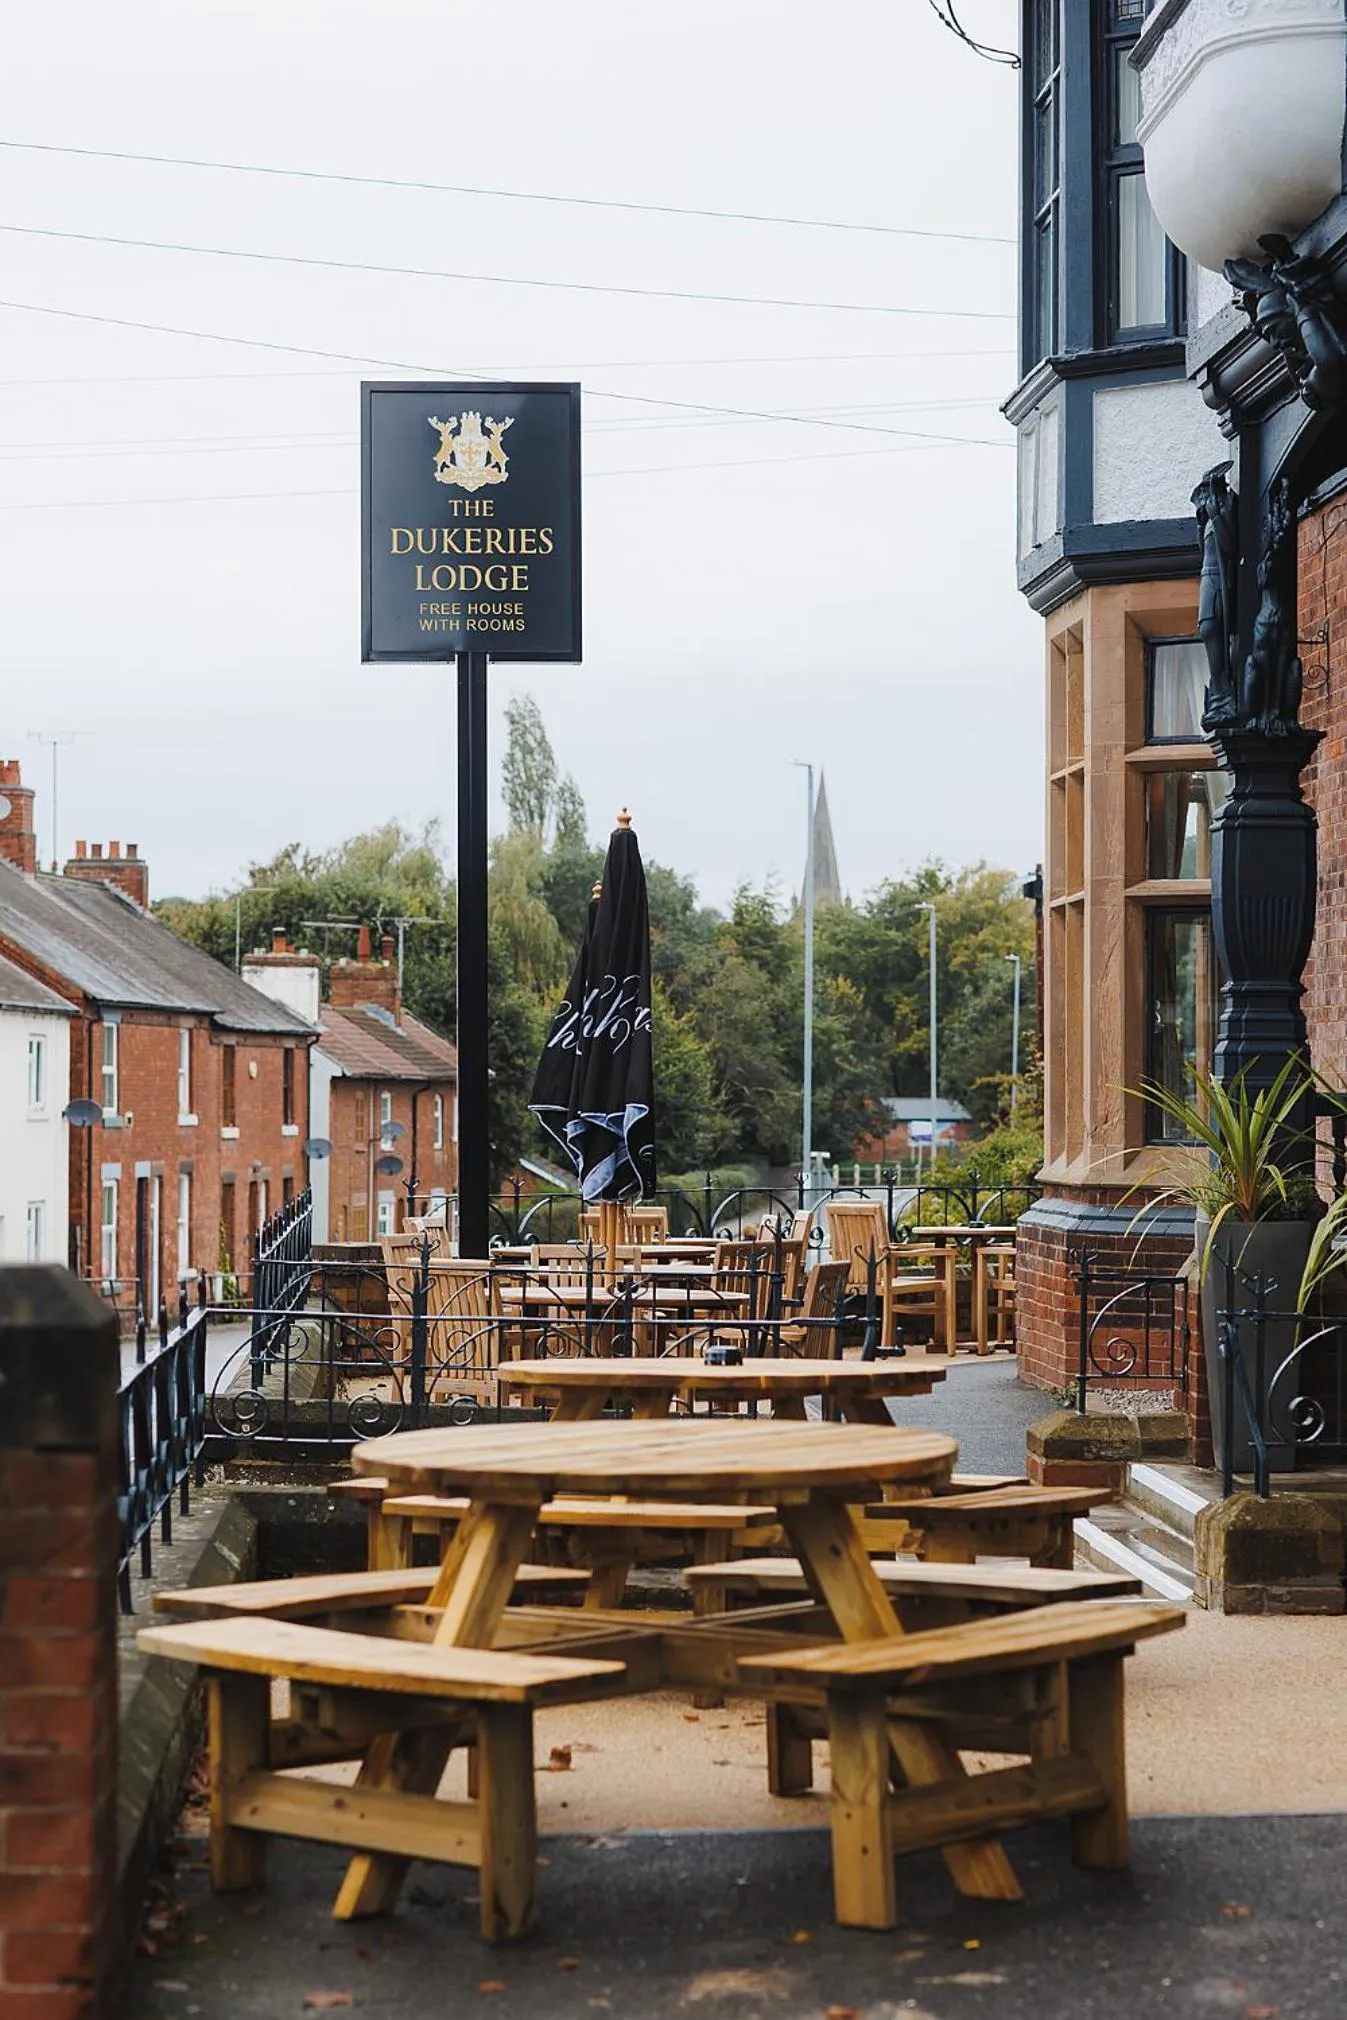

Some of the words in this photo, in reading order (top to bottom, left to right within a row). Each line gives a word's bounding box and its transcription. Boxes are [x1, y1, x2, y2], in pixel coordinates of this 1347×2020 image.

[448, 500, 494, 517] THE
[391, 528, 554, 555] DUKERIES
[415, 565, 529, 591] LODGE
[419, 602, 461, 615] FREE
[468, 602, 524, 615] HOUSE
[419, 618, 460, 631] WITH
[466, 618, 526, 631] ROOMS
